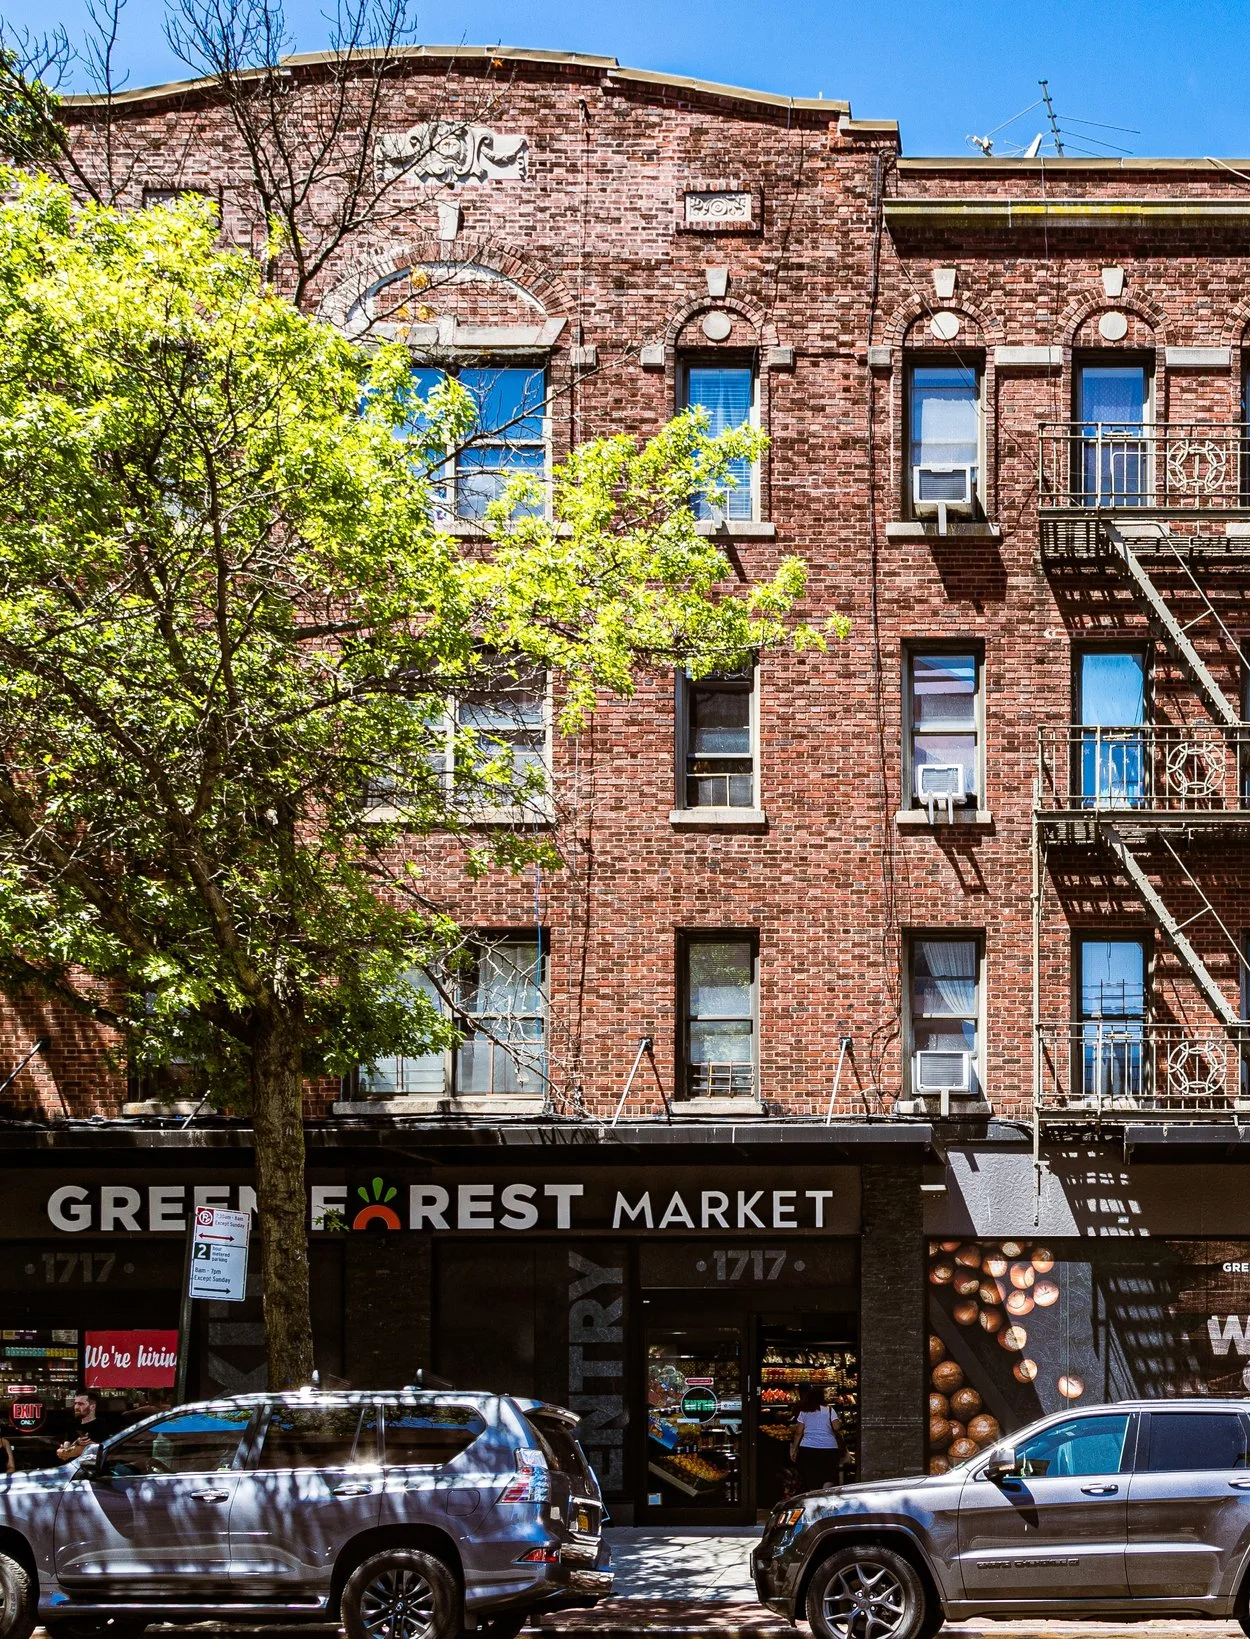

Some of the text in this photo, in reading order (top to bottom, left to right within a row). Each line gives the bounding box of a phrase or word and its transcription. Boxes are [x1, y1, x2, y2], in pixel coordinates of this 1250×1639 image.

[612, 1190, 834, 1229] MARKET
[197, 1244, 206, 1258] 2
[41, 1251, 117, 1284] 1717
[712, 1249, 786, 1281] 1717
[194, 1274, 231, 1284] Except Sunday
[85, 1345, 131, 1369] We're
[13, 1403, 43, 1419] EXIT
